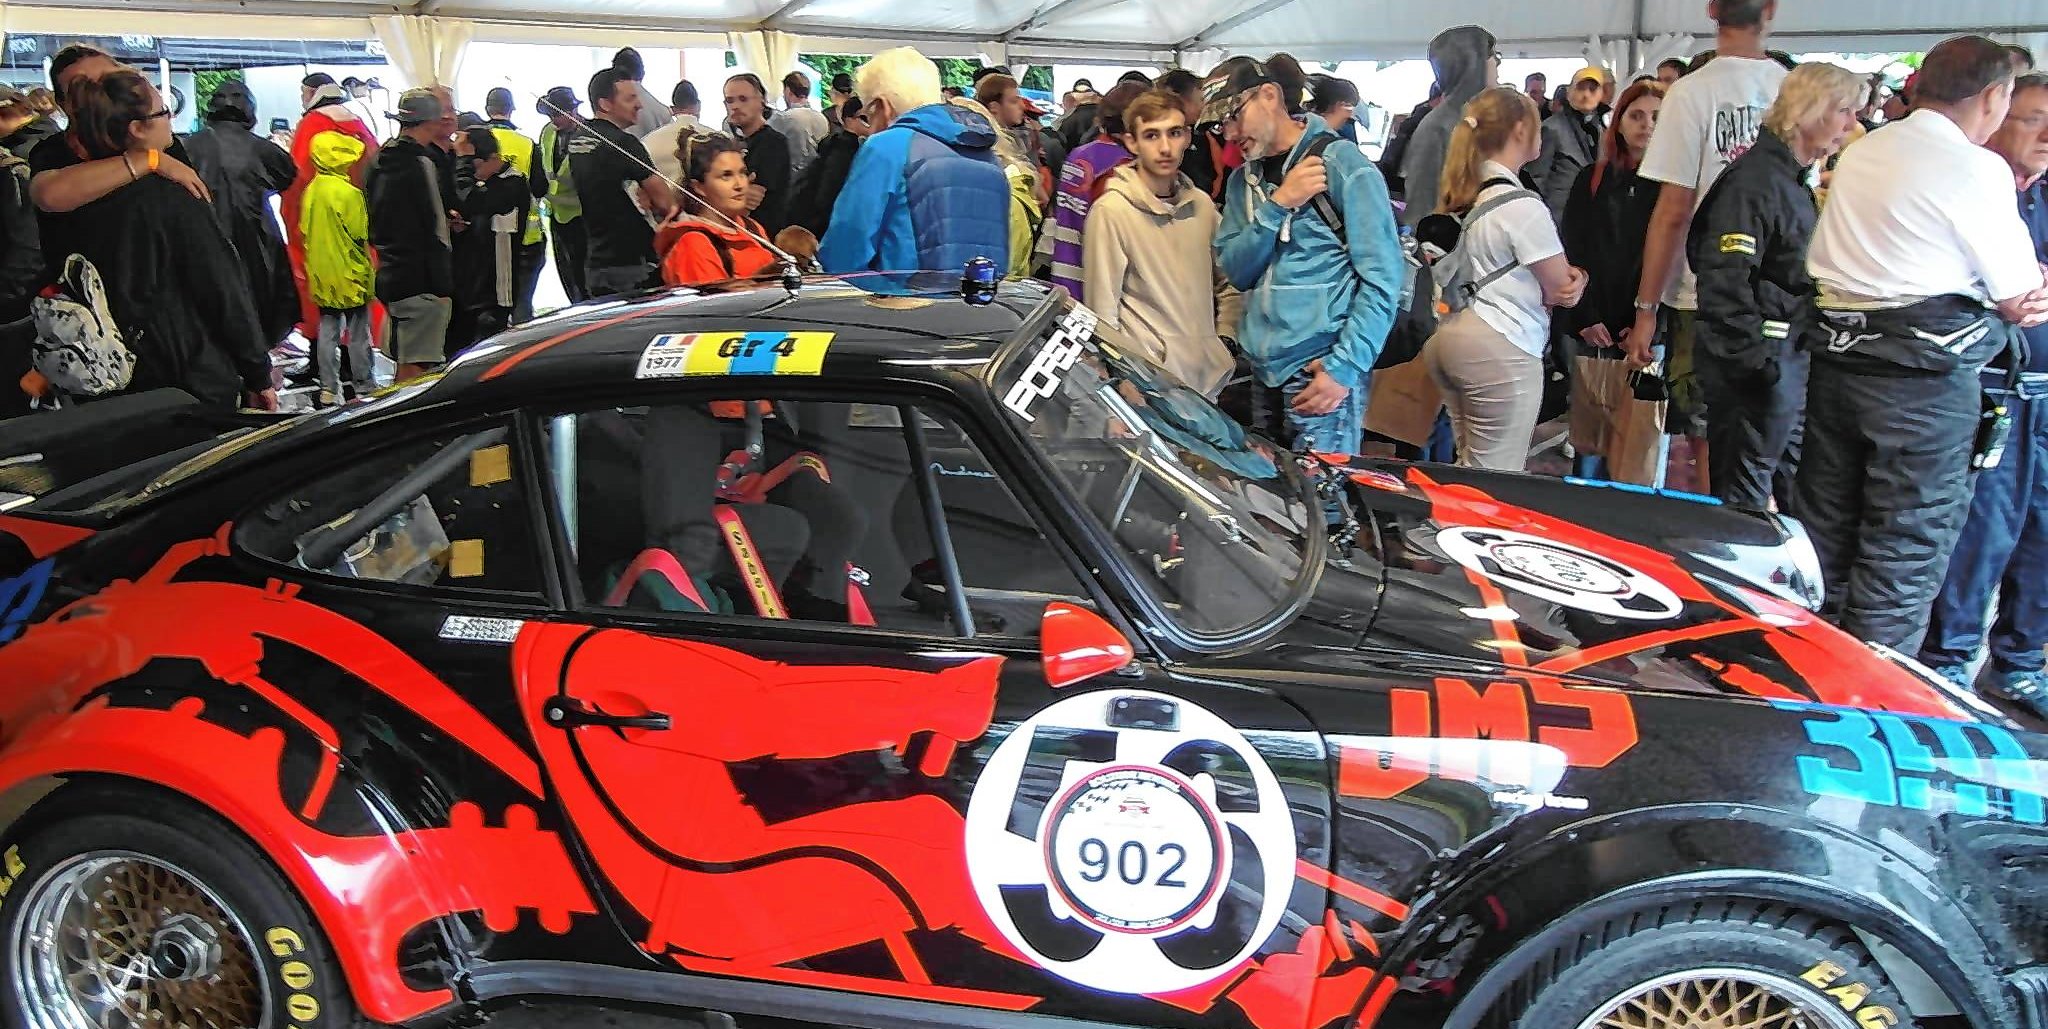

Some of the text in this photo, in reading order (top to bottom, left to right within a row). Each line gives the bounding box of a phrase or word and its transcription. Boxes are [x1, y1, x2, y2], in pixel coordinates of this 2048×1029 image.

[645, 356, 683, 370] 1977
[717, 337, 798, 358] Gr 4
[1079, 838, 1187, 887] 902
[265, 926, 320, 1029] GOO
